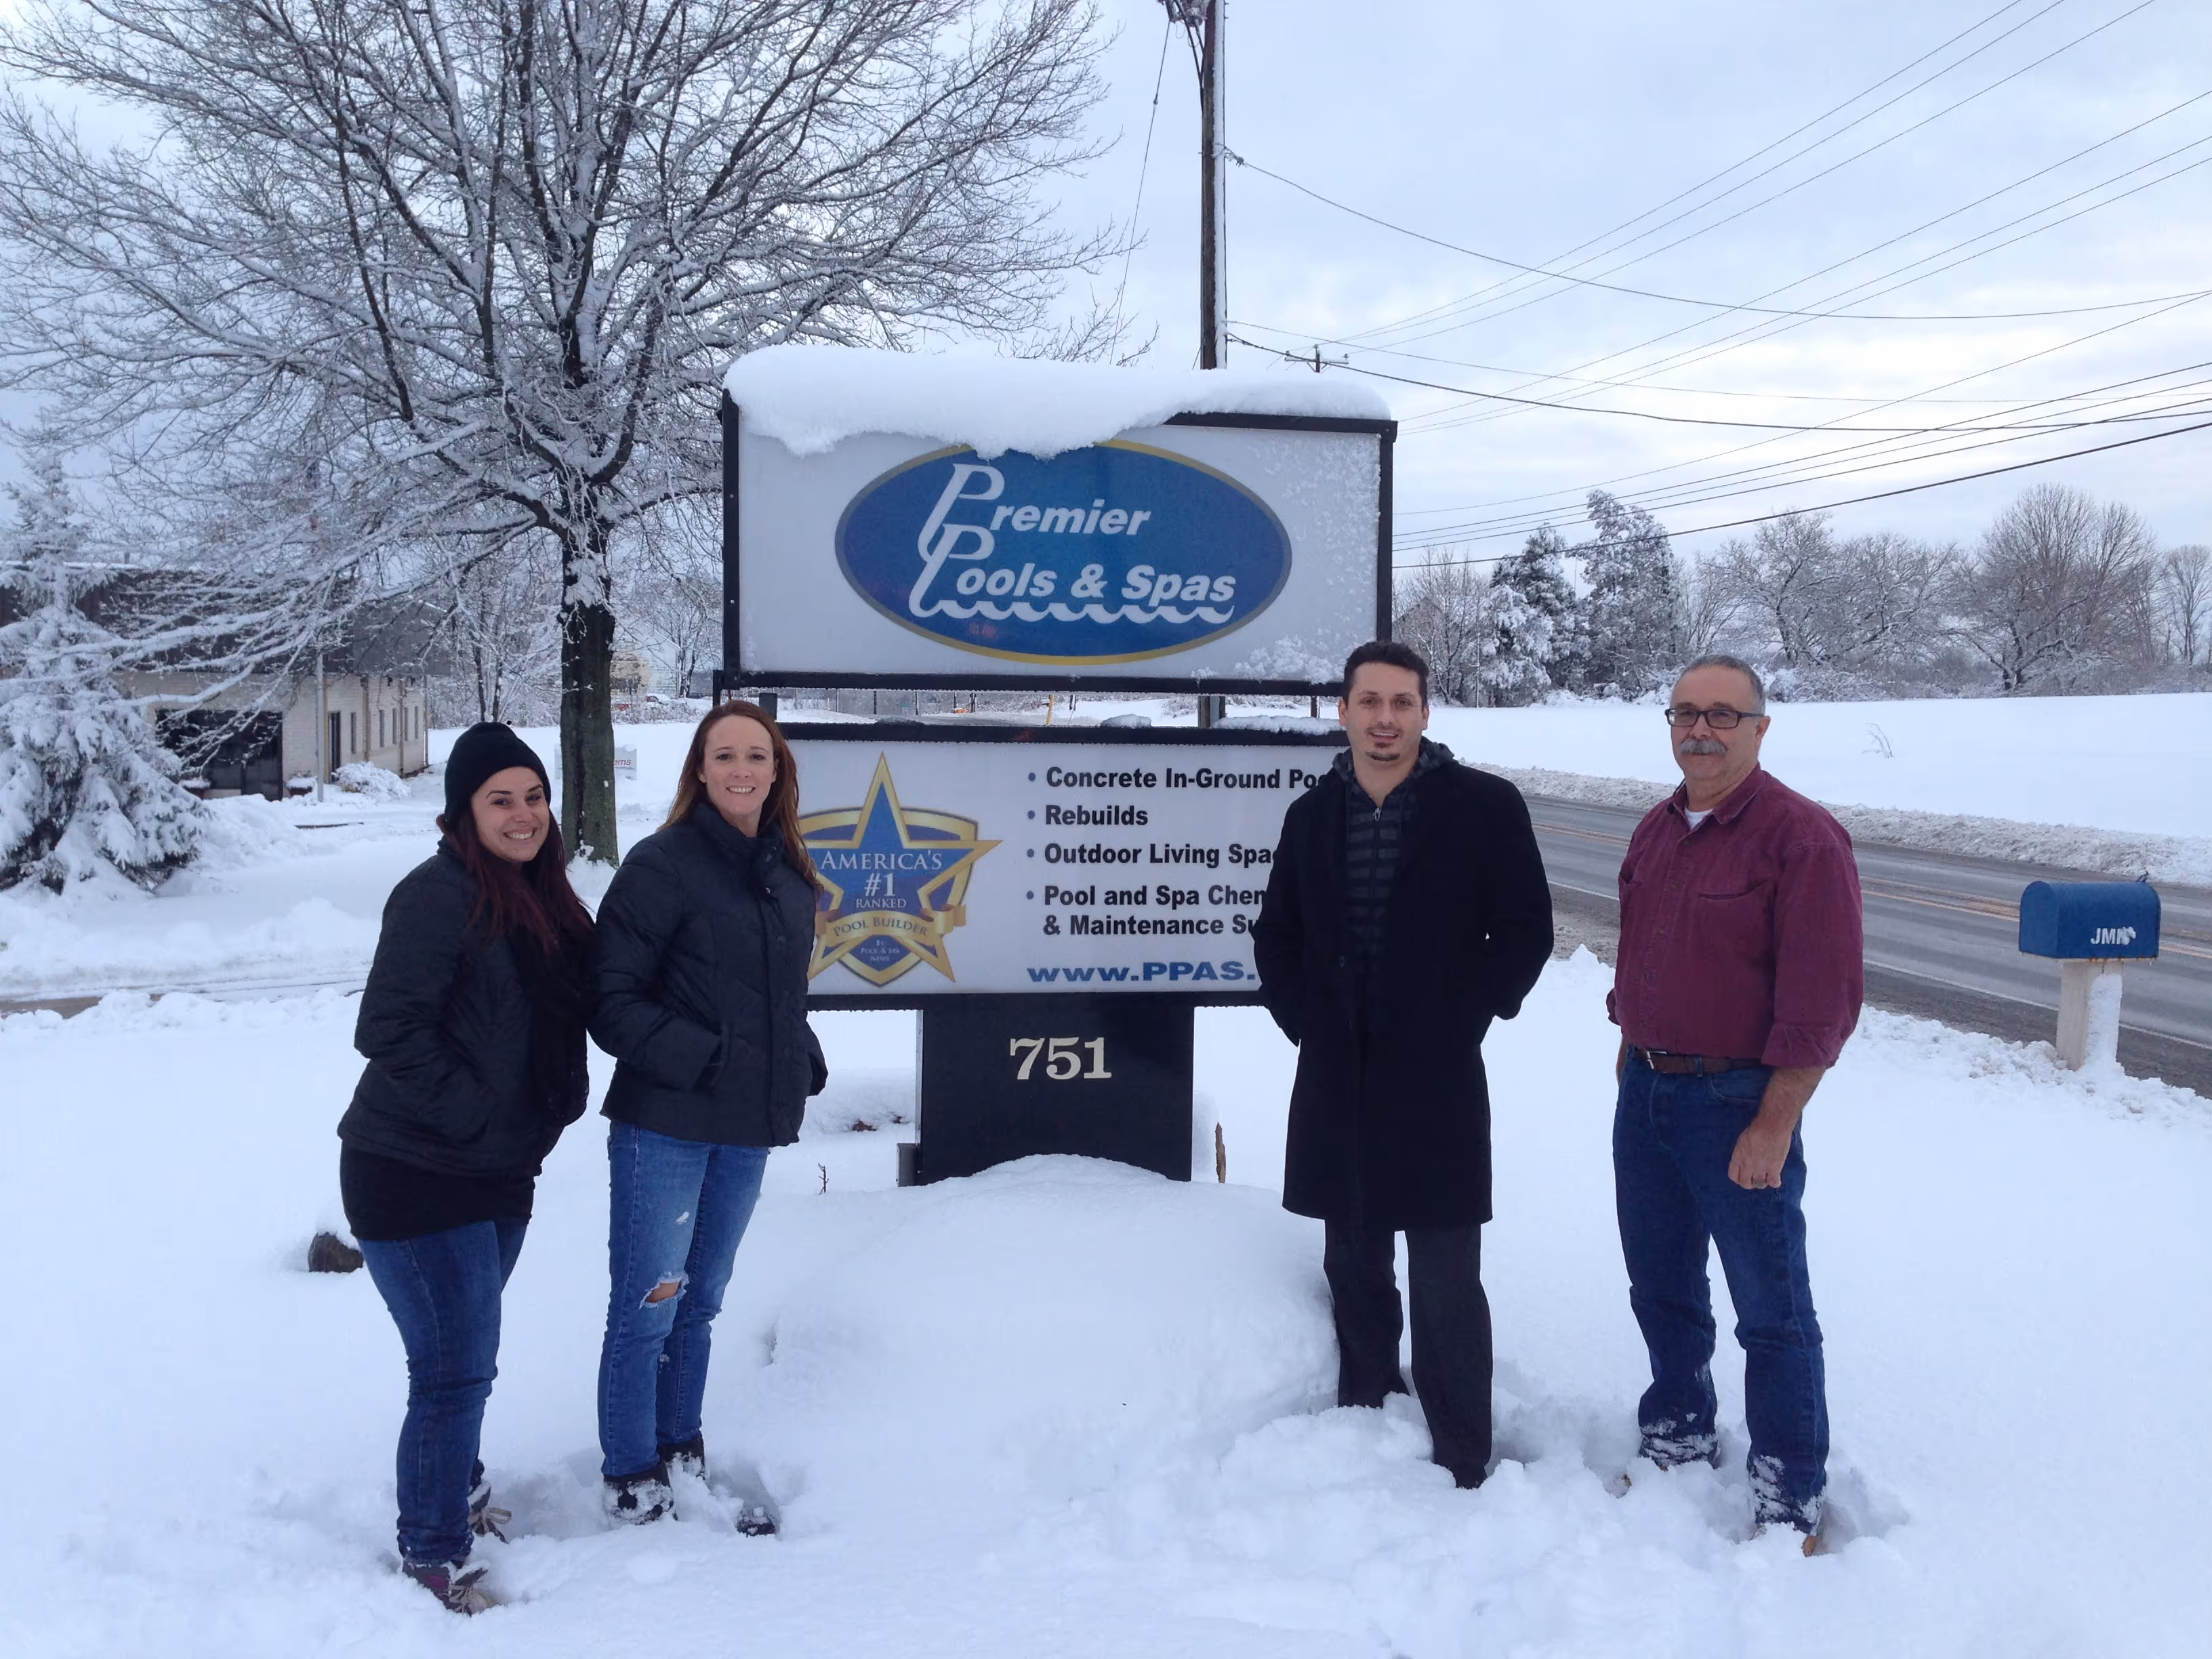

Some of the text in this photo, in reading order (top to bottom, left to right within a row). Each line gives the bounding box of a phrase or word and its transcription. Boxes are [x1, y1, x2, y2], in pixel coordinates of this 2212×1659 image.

[918, 463, 1151, 562] Premier
[908, 523, 1237, 617] Pools & Spas
[1046, 766, 1158, 788] Concrete
[1166, 768, 1281, 789] In-Ground
[1045, 805, 1149, 826] Rebuilds
[820, 850, 943, 869] AMERICA'S
[1044, 843, 1277, 869] Outdoor Living Spa
[864, 872, 897, 897] #1
[856, 898, 907, 908] RANKED
[1044, 885, 1095, 905] Pool
[1104, 885, 1147, 905] and
[1155, 885, 1200, 910] Spa
[833, 917, 928, 937] POOL BUILDER
[1043, 915, 1061, 935] &
[1069, 915, 1224, 935] Maintenance
[1010, 1037, 1112, 1080] 751
